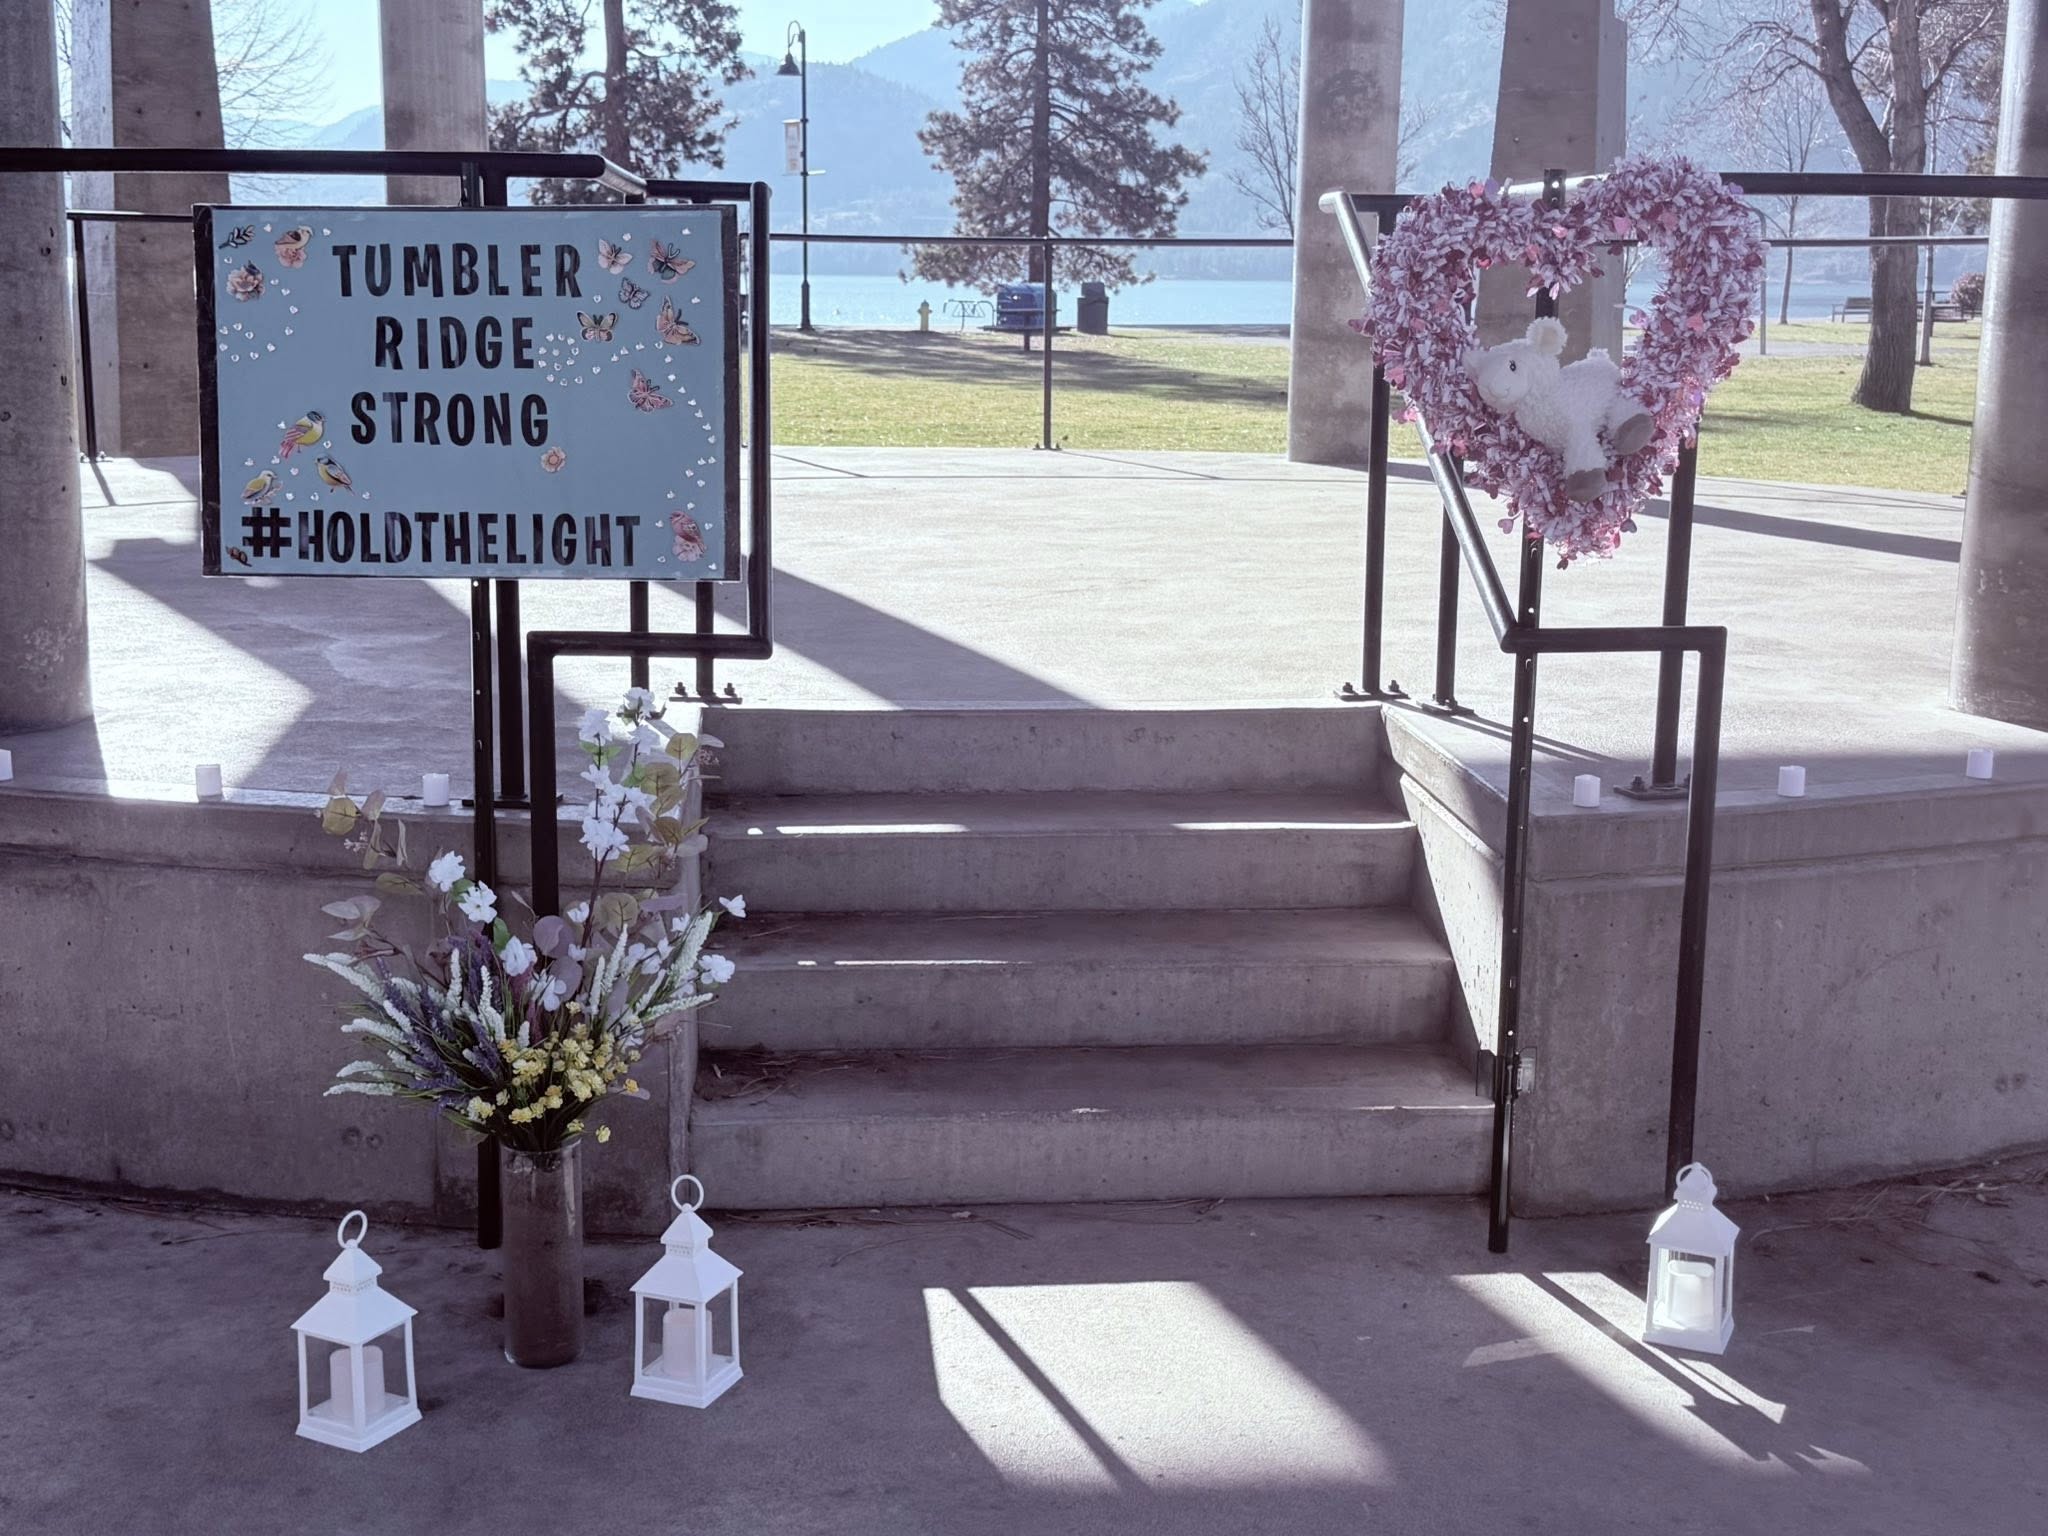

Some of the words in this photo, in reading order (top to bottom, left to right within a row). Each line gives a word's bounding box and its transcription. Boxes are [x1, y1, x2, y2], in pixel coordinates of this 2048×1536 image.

[331, 243, 582, 298] TUMBLER
[374, 315, 535, 370] RIDGE
[350, 391, 549, 447] STRONG
[241, 506, 641, 567] #HOLDTHELIGHT
